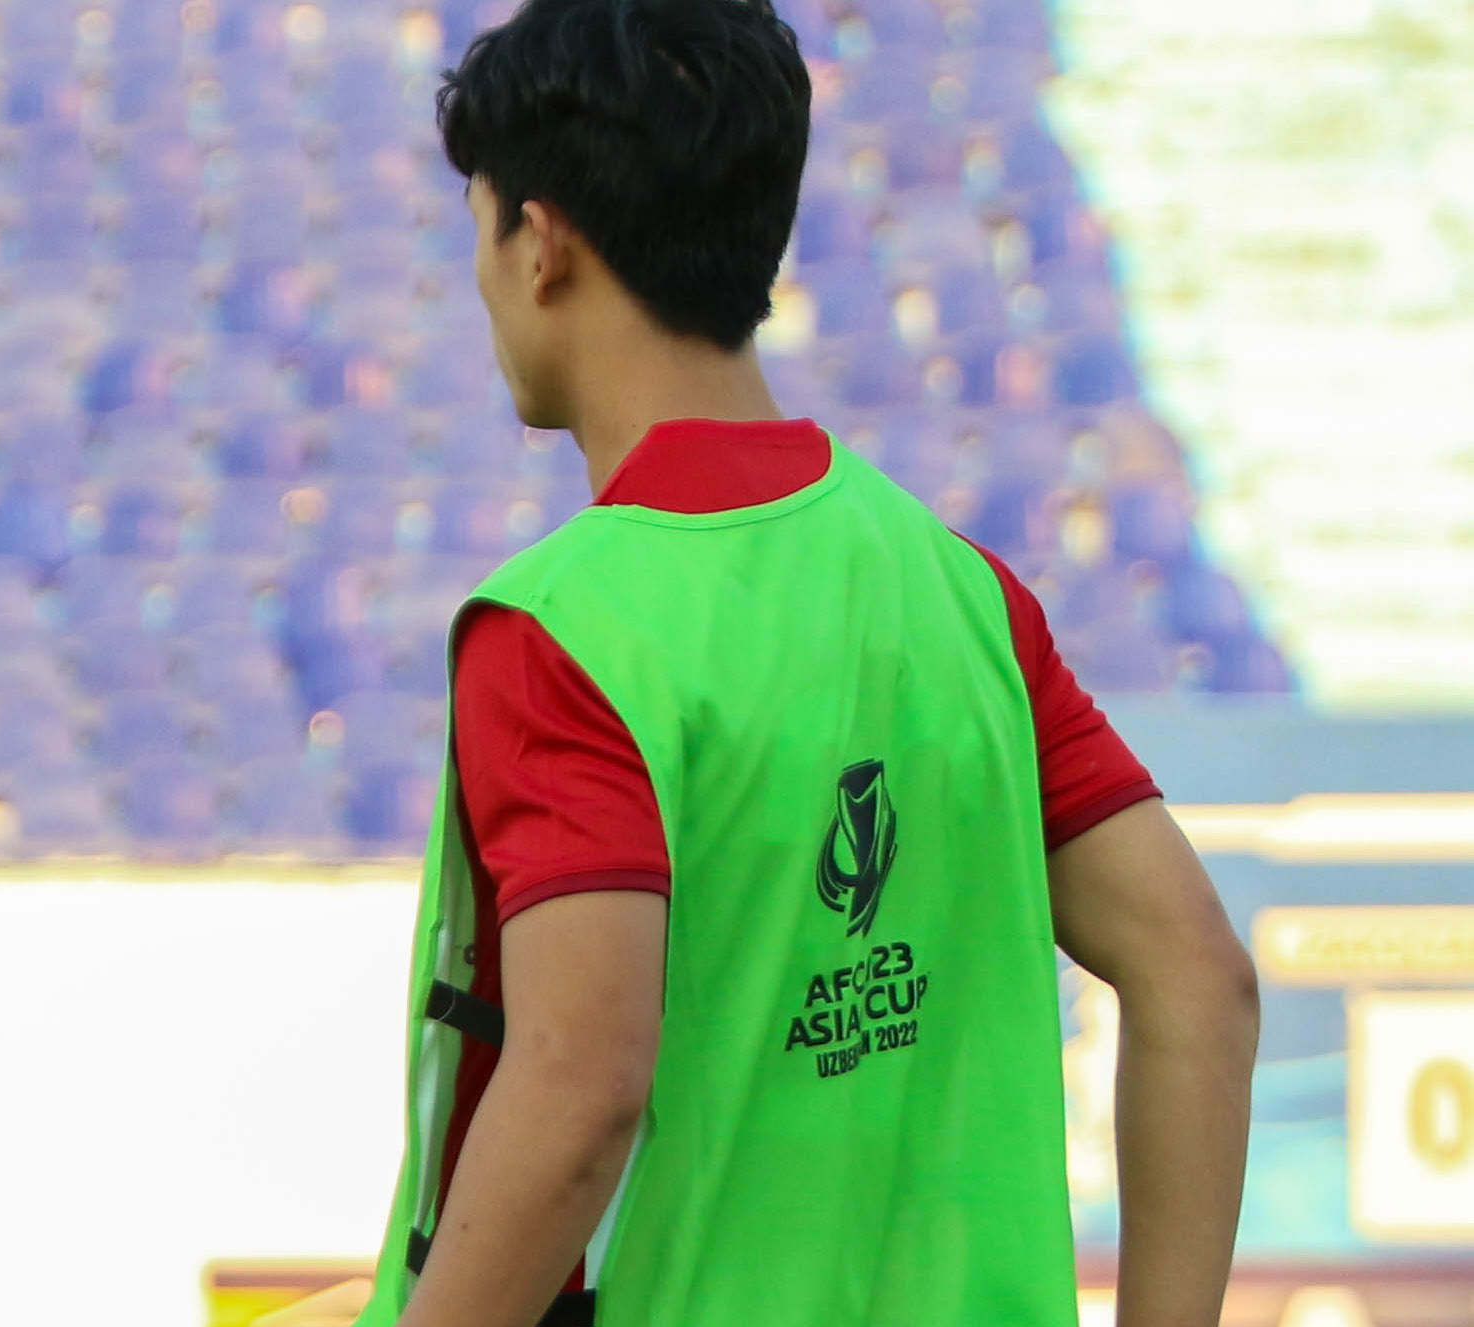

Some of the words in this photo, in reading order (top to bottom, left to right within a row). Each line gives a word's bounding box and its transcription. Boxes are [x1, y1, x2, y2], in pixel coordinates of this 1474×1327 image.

[804, 960, 865, 1009] AFC
[865, 941, 915, 982] 23
[784, 1004, 861, 1052] ASIA
[864, 974, 929, 1020] CUP
[874, 1018, 919, 1052] 2022
